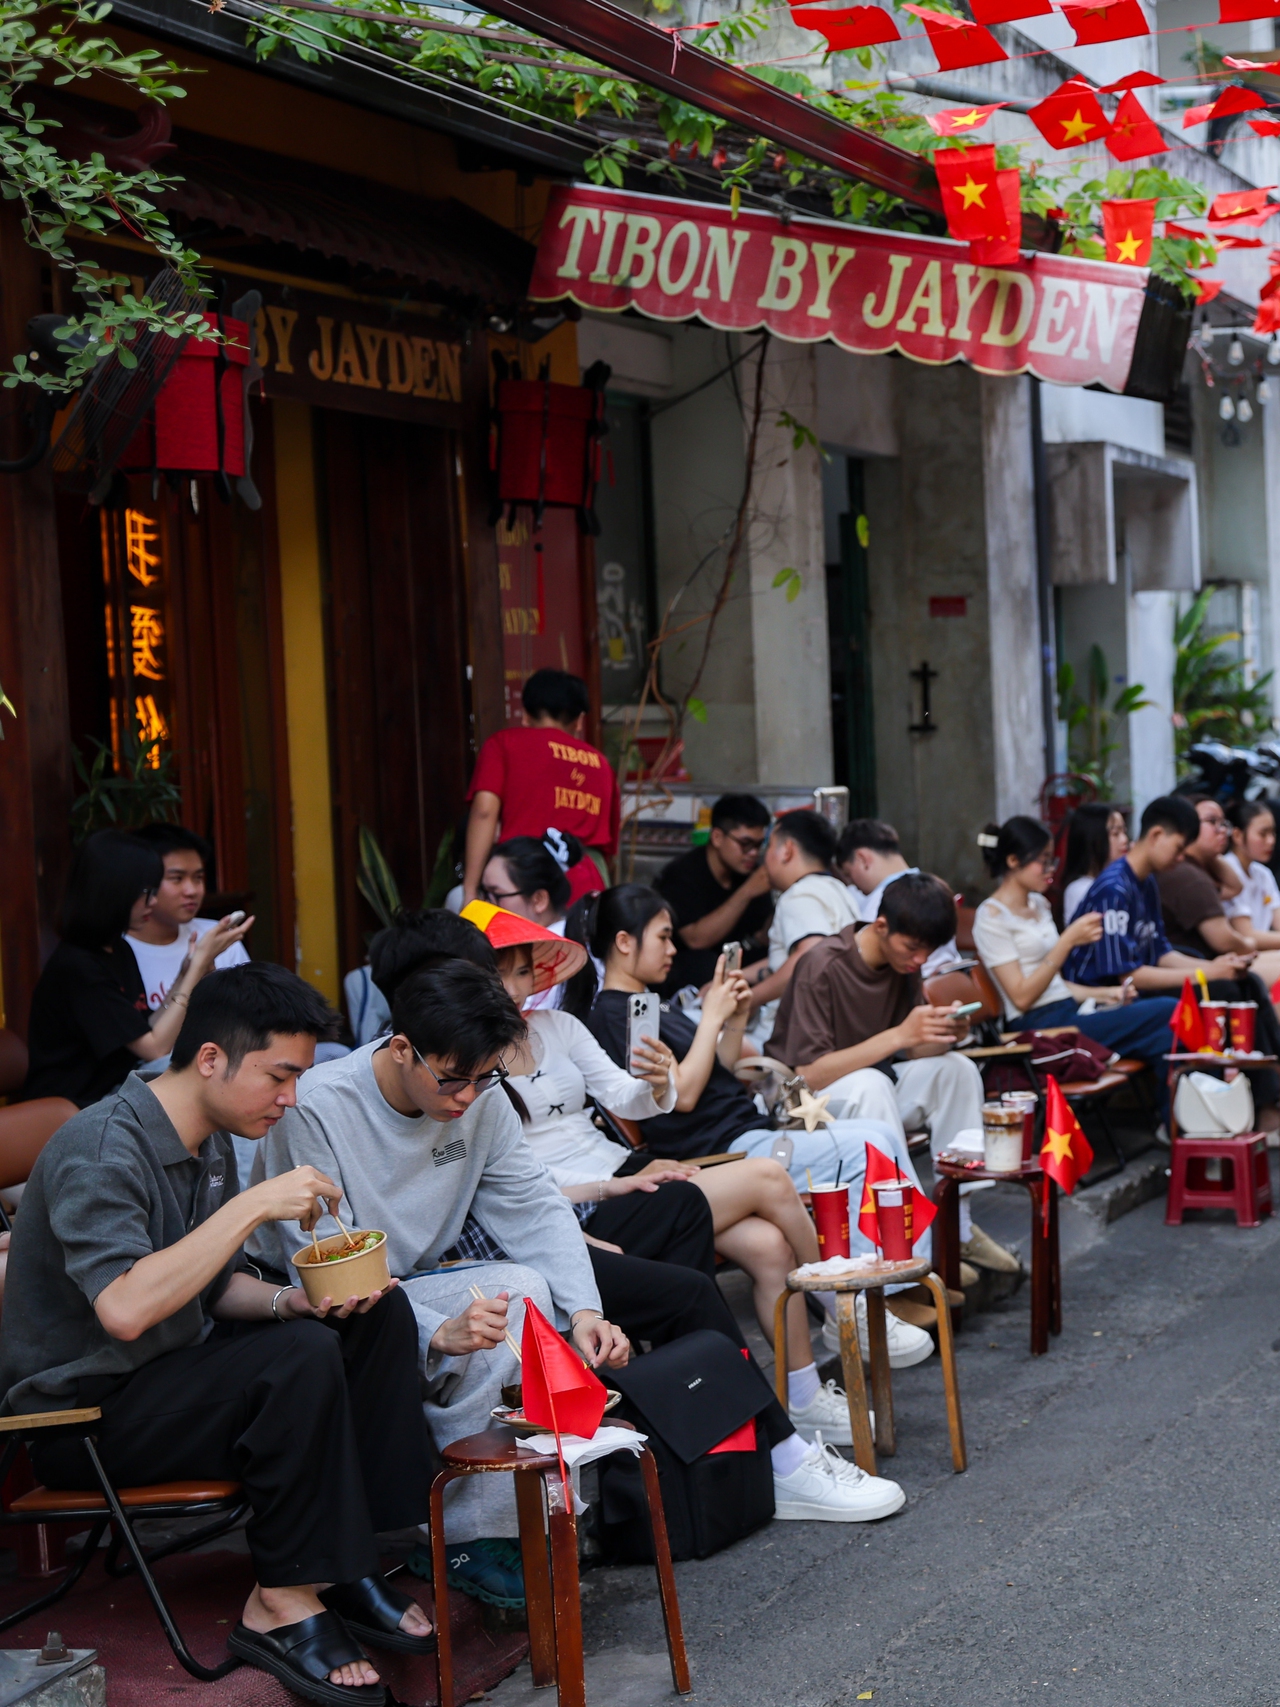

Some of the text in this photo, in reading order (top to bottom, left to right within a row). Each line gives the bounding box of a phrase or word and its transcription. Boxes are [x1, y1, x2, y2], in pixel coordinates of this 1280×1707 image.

[556, 205, 1128, 365] TIBON BY JAYDEN
[308, 317, 462, 402] JAYDEN
[548, 741, 601, 769] TIBON
